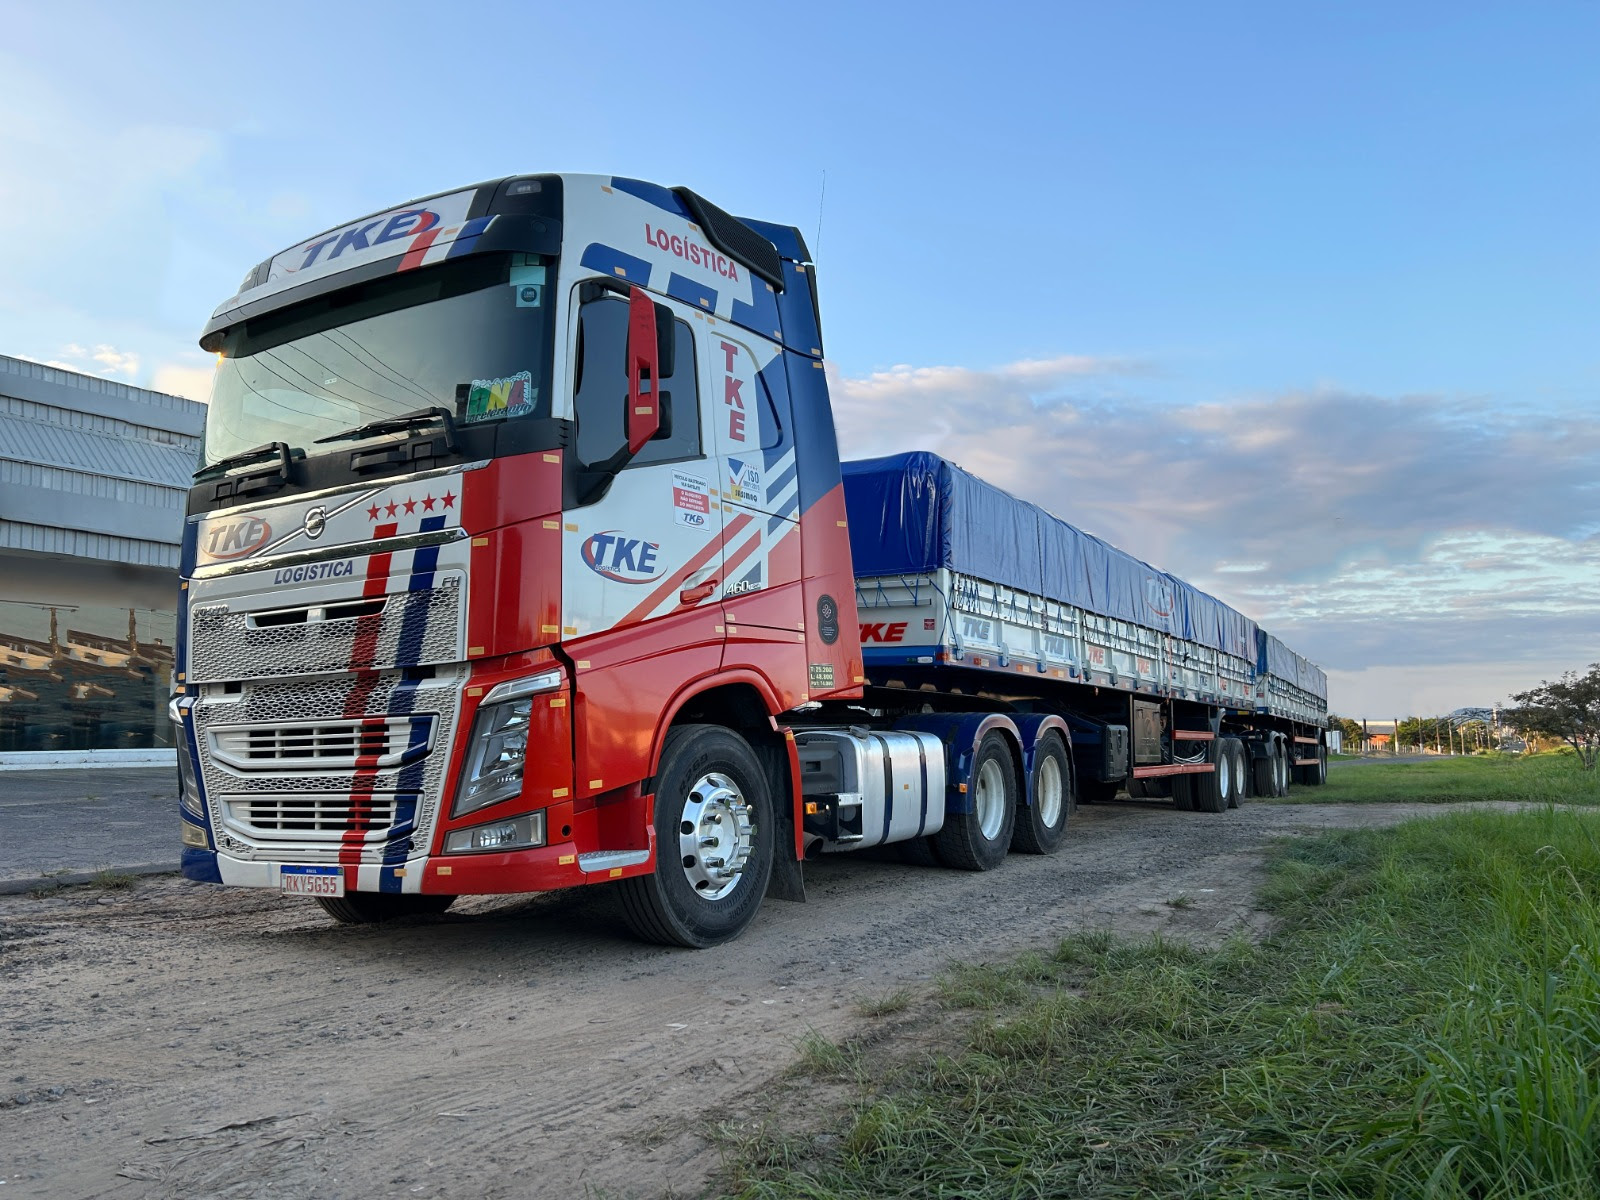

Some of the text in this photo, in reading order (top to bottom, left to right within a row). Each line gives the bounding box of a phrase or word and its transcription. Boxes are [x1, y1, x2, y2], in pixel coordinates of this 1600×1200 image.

[299, 208, 430, 271] TKE
[645, 223, 739, 283] LOGÍSTICA
[720, 340, 746, 443] TKE
[748, 469, 760, 484] ISO
[684, 513, 704, 524] TKE
[209, 518, 267, 554] TKE
[592, 533, 660, 574] TKE
[726, 580, 749, 594] 460
[859, 622, 908, 643] KE
[963, 616, 990, 640] TKE
[1044, 635, 1064, 655] TKE
[1088, 646, 1104, 665] TKE
[286, 875, 337, 894] RKY5G55
